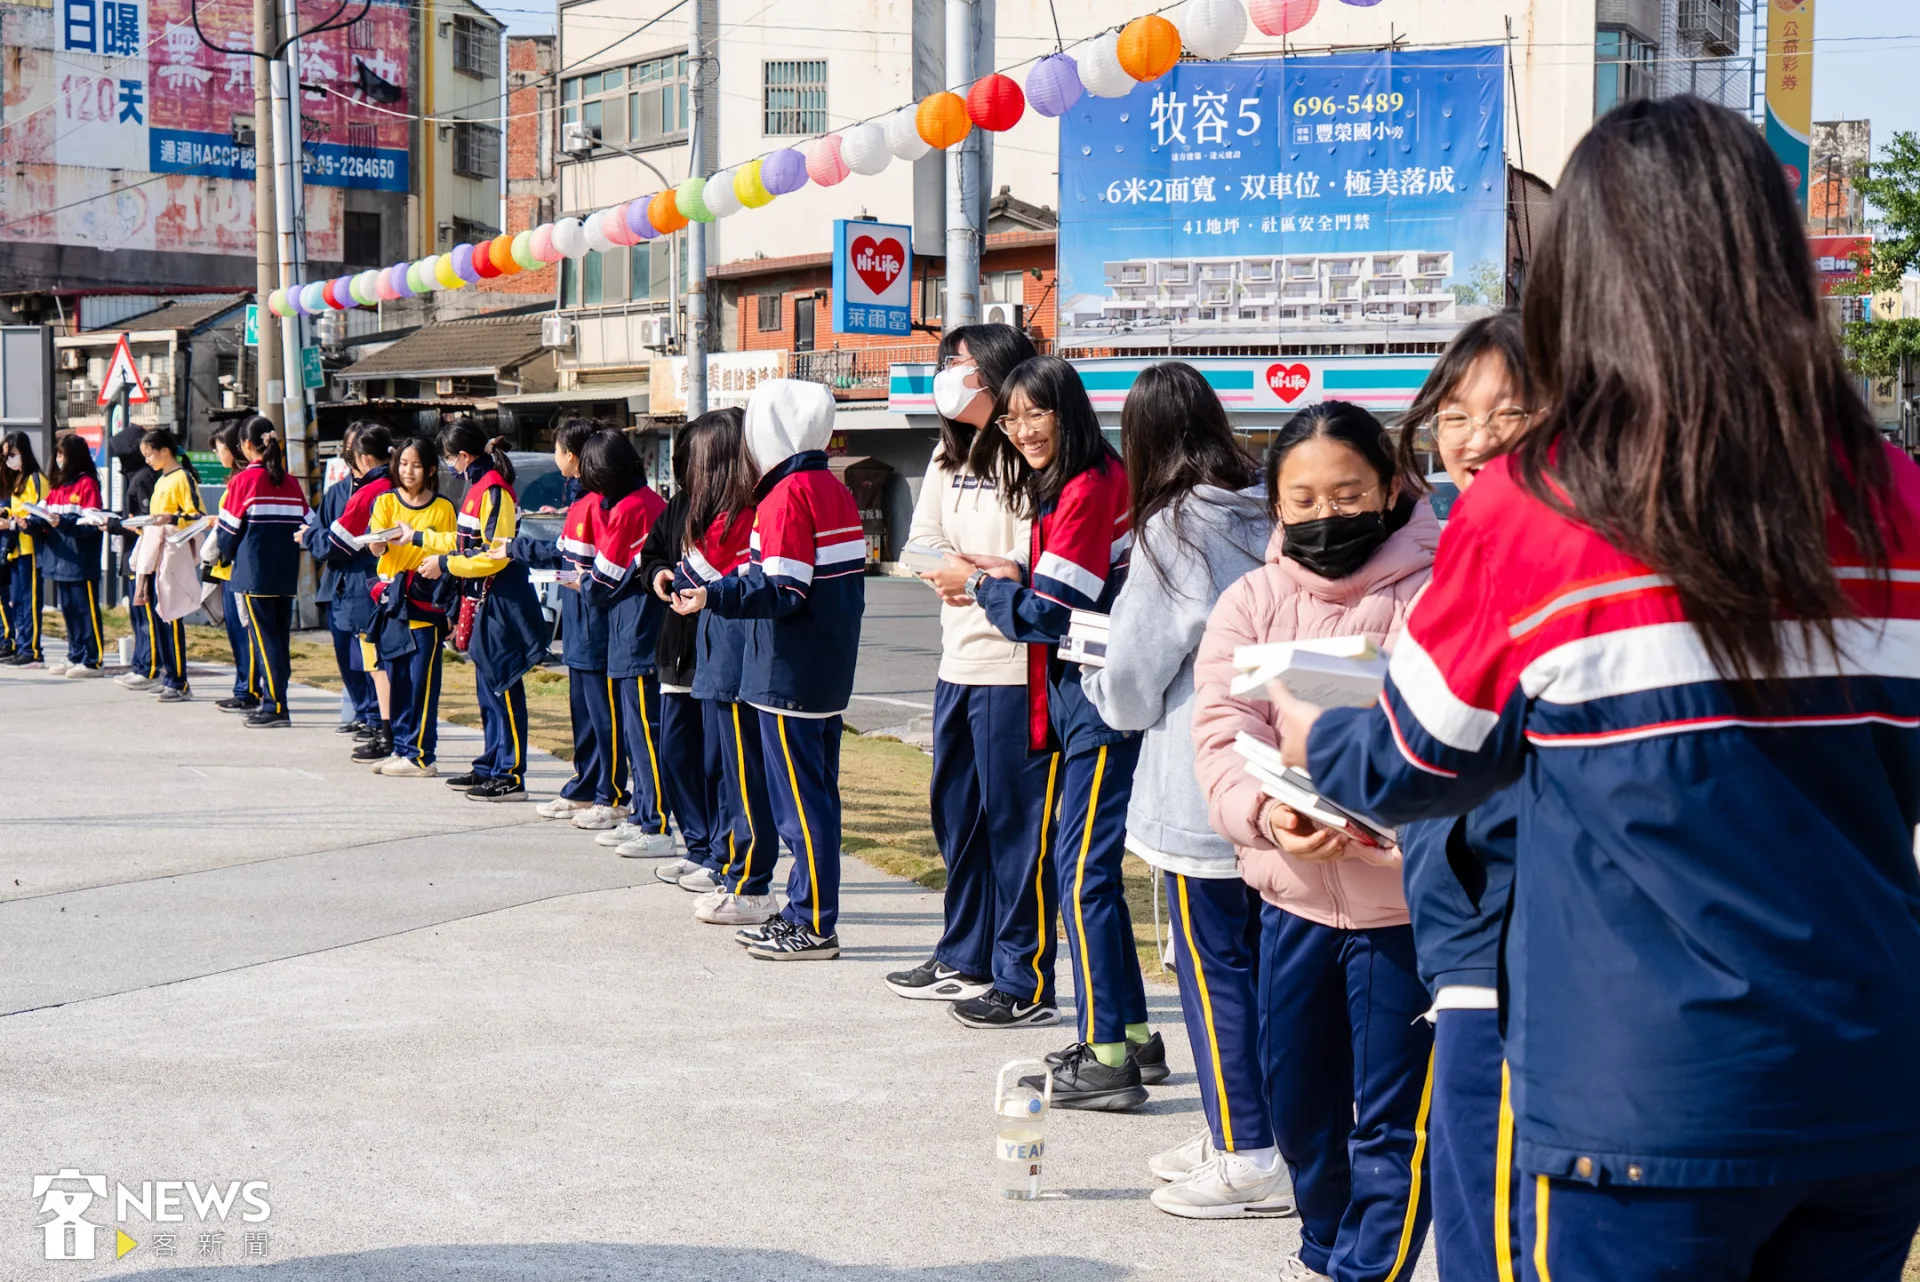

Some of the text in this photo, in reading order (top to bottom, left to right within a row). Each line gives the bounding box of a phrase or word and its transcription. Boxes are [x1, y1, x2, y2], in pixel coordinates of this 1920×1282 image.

[1781, 20, 1799, 91] 公益彩券
[1293, 92, 1404, 117] 696-5489
[848, 307, 907, 330] 萊爾富
